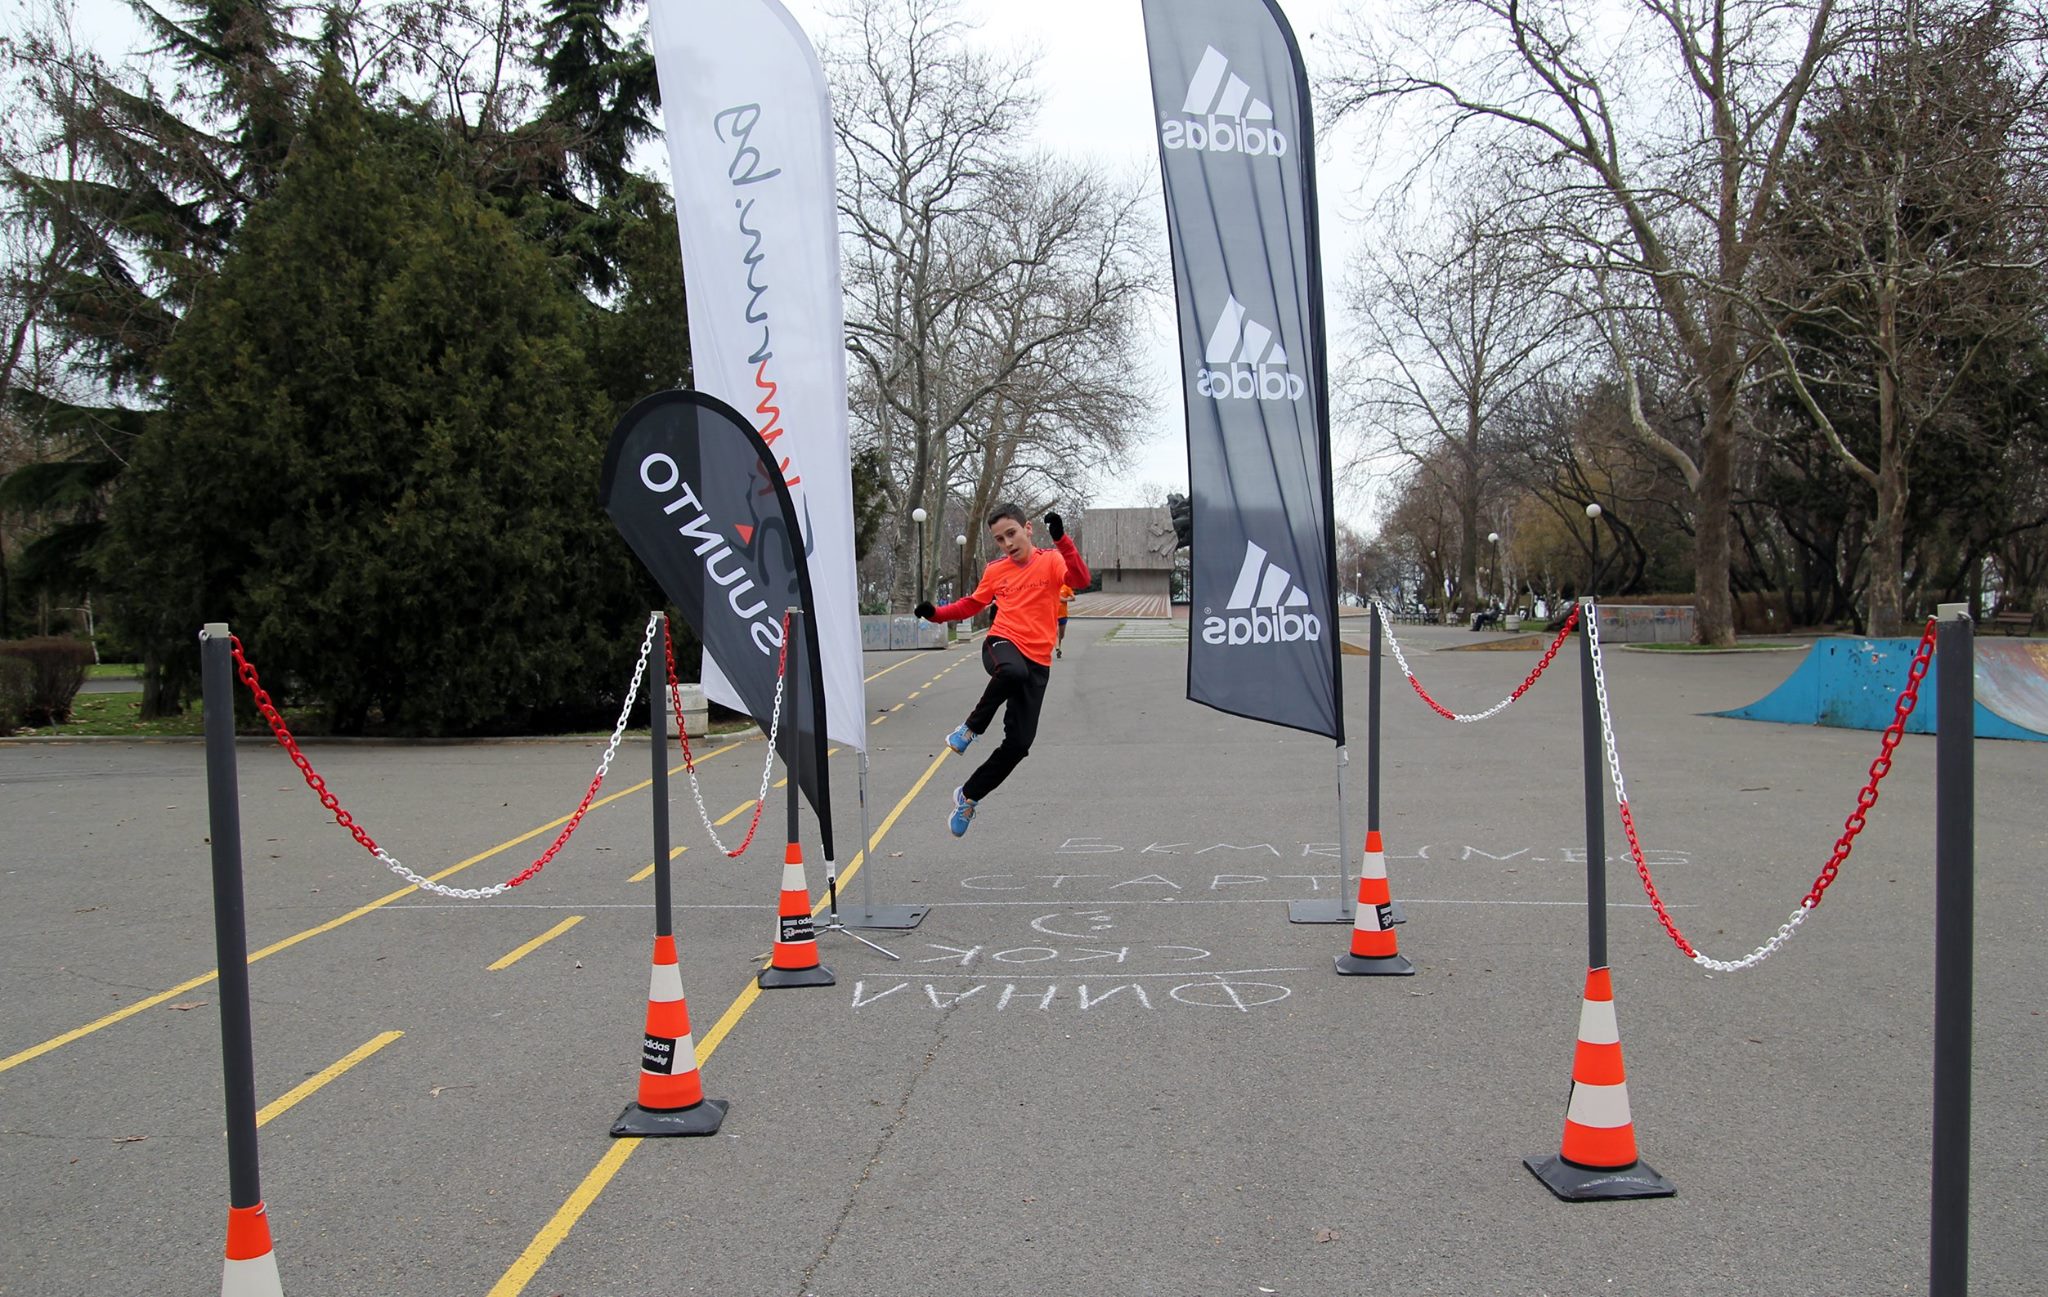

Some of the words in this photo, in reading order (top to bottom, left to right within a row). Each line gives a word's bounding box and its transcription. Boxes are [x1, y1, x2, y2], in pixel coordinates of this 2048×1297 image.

[961, 873, 1360, 891] СТАРТ
[914, 944, 1211, 966] СКОК
[850, 974, 1292, 1012] ФИНАЛ
